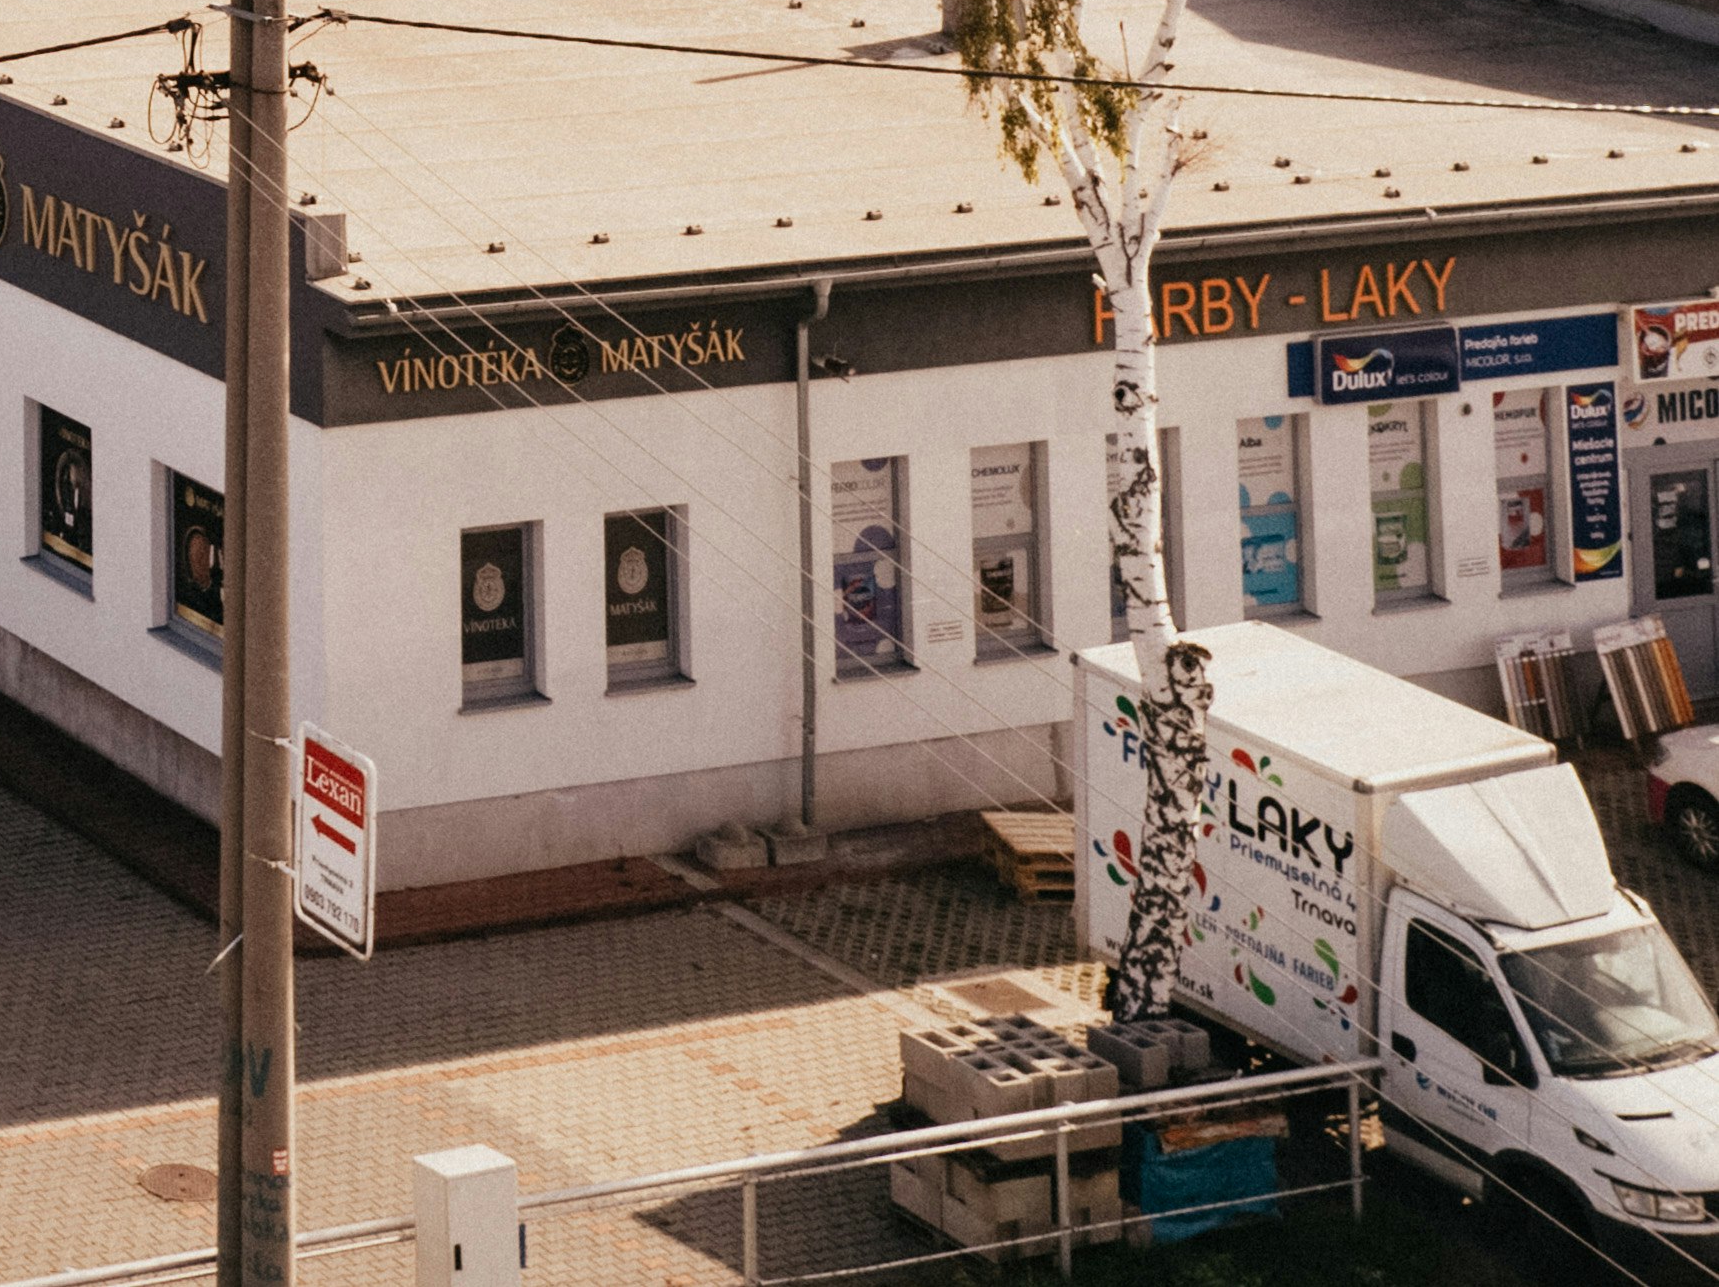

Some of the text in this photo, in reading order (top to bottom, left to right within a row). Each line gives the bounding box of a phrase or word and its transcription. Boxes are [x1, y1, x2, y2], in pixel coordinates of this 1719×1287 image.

[20, 182, 209, 324] MATYŠÁK
[1094, 273, 1271, 344] FRBY
[1320, 256, 1457, 323] LAKY
[377, 320, 746, 394] VÍNOTÉKA MATYŠÁK
[1332, 370, 1388, 392] Dulux
[1570, 404, 1610, 420] Dulux
[1657, 388, 1719, 424] MICO
[306, 754, 363, 817] Lexan
[1228, 778, 1355, 878] LAKY
[1230, 832, 1357, 912] Priemyselná 4
[1290, 887, 1357, 937] Trnava
[1292, 958, 1335, 991] FARIEB
